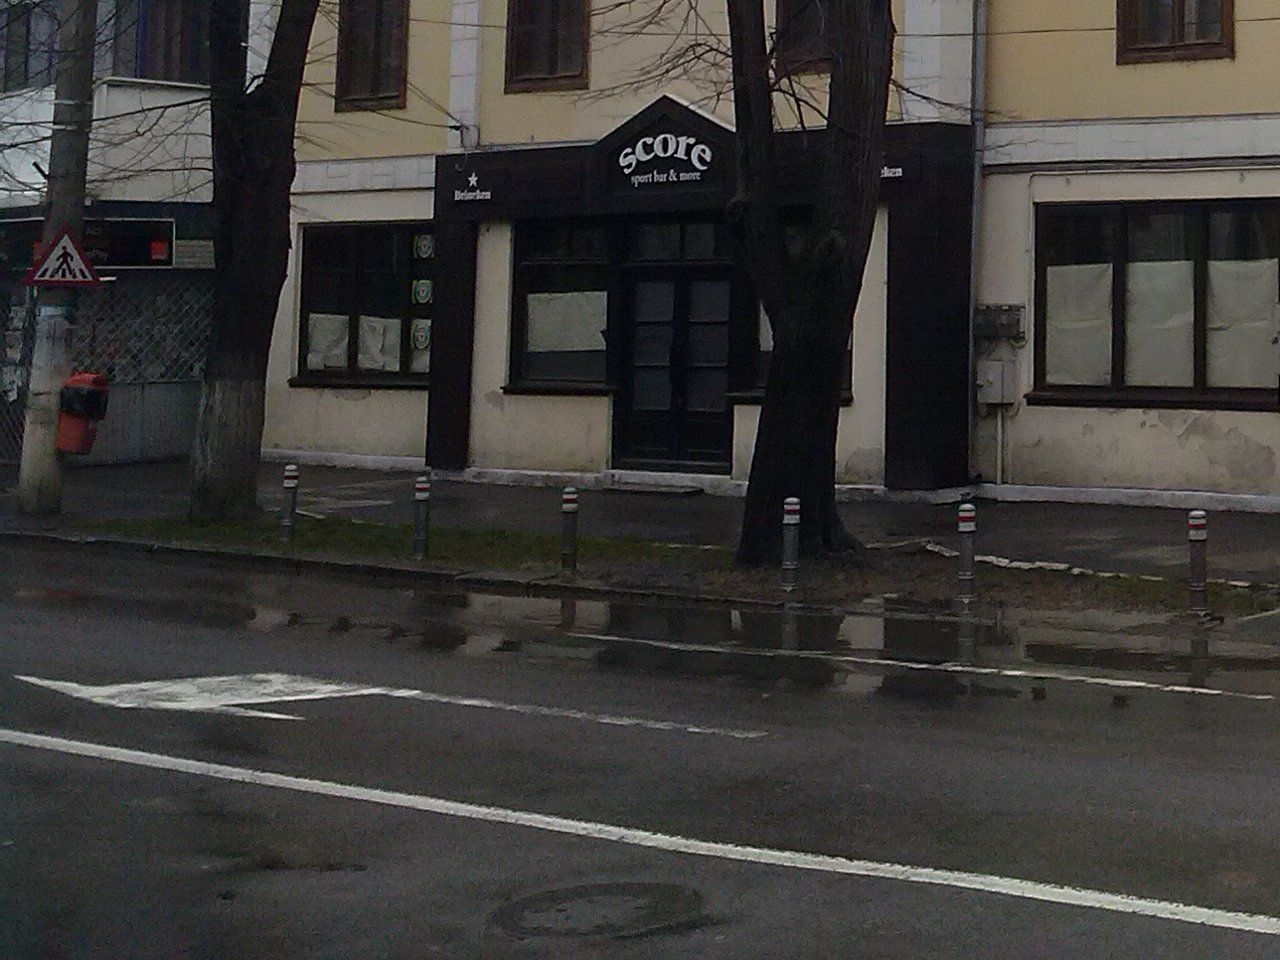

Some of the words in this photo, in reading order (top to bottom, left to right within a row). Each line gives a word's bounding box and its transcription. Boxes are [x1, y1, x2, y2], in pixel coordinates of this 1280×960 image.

[631, 173, 652, 187] sport
[654, 170, 667, 182] bar
[680, 172, 701, 181] more
